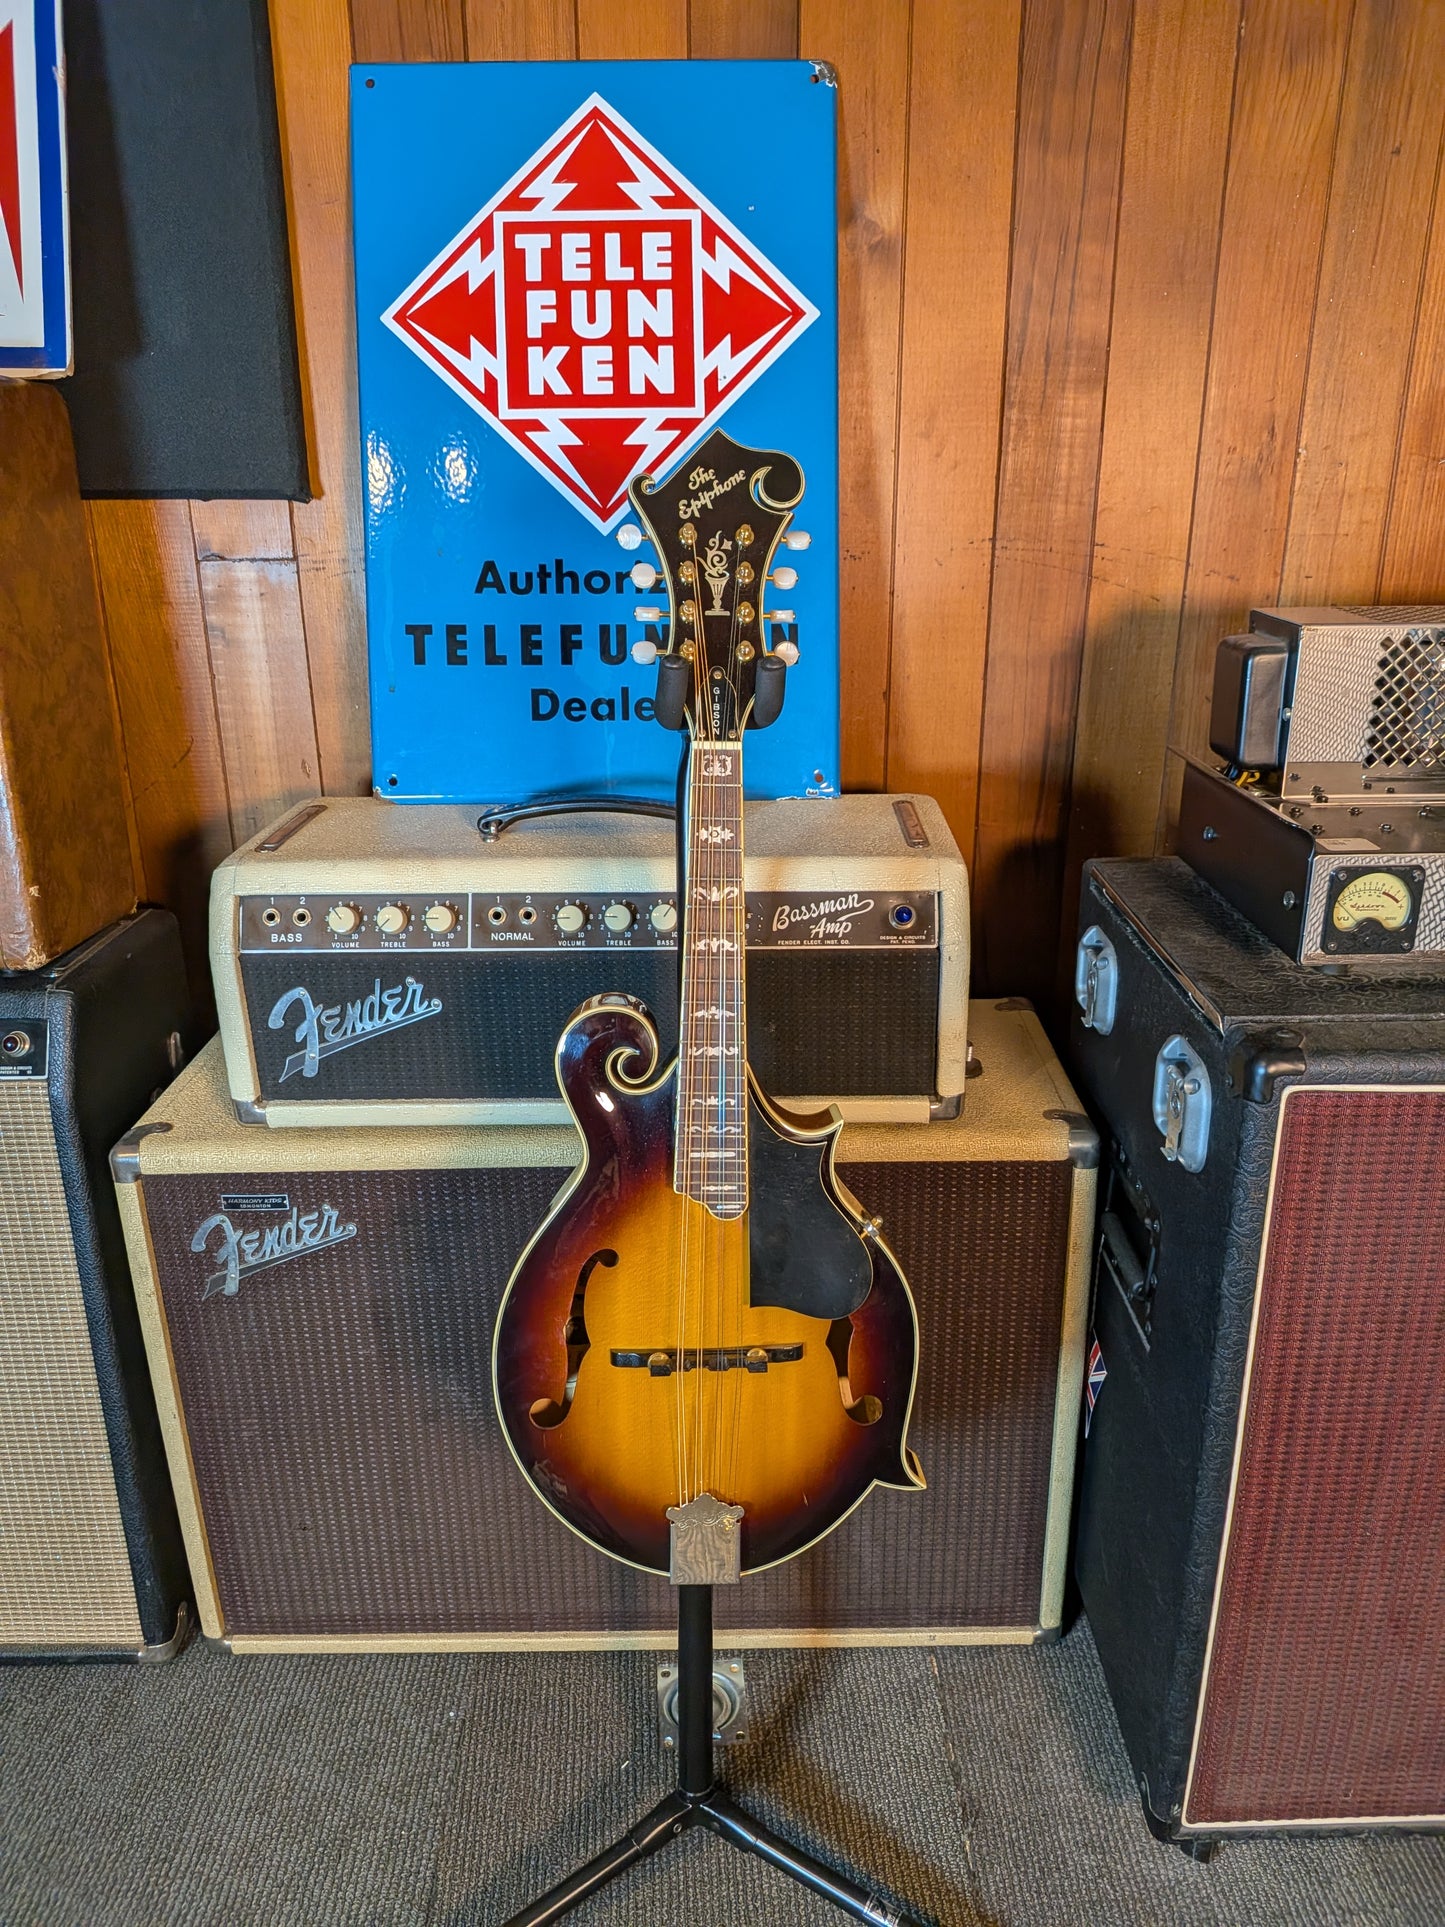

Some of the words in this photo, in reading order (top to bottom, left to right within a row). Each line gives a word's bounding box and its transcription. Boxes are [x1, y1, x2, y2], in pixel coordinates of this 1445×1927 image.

[514, 231, 673, 282] TELE
[525, 288, 674, 340] FUN
[526, 345, 676, 396] KEN
[678, 469, 747, 520] Epiphone
[688, 465, 716, 490] The
[474, 558, 667, 595] Authorz
[405, 624, 798, 666] TELEFUNN
[530, 686, 656, 723] Deale
[712, 686, 721, 735] GIBSON
[270, 897, 275, 905] 1
[299, 896, 306, 905] 2
[496, 895, 500, 904] 1
[525, 895, 532, 904] 2
[772, 893, 874, 932] Bassman
[271, 933, 303, 942] BASS
[491, 932, 535, 941] NORMAL
[809, 917, 852, 938] Amp
[268, 976, 442, 1083] Fender
[191, 1204, 357, 1302] Fender
